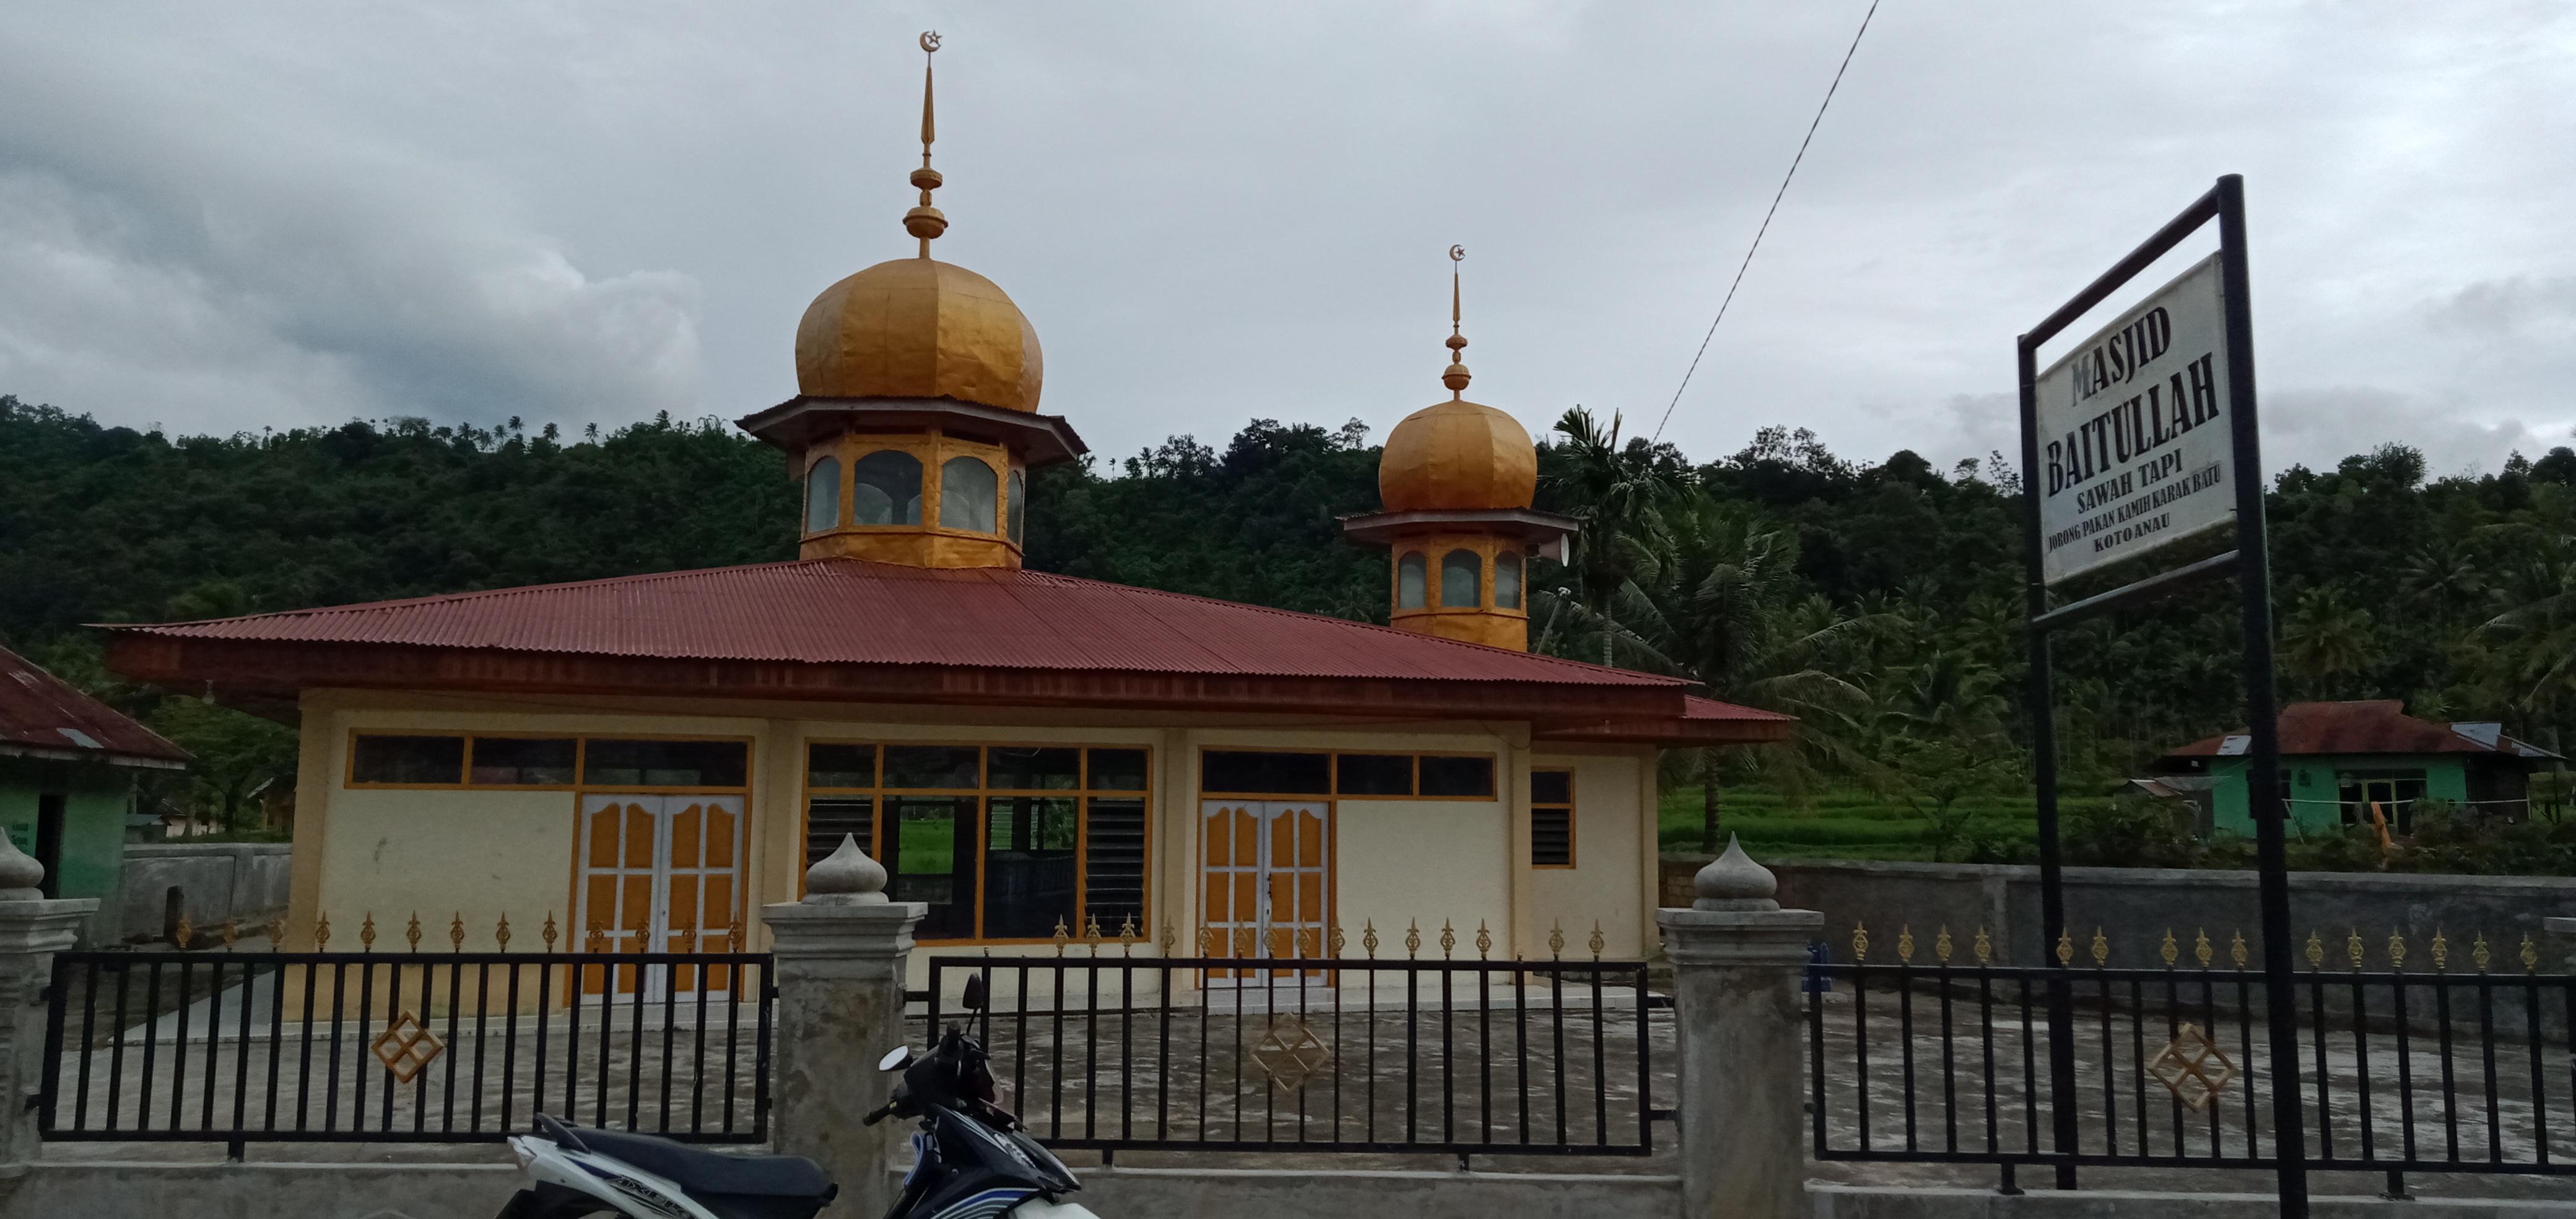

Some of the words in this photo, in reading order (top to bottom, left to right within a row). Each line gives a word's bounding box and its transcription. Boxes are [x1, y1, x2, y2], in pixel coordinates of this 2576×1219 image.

[2072, 306, 2172, 407] MASJID
[2047, 351, 2219, 497] BAITULLAH
[2049, 524, 2081, 553] JORONG
[2082, 510, 2115, 537] PAKAN
[2152, 477, 2191, 509] KARAK
[2193, 464, 2221, 493] BATU
[2077, 471, 2133, 514] SAWAH
[2138, 448, 2183, 487] TAPI
